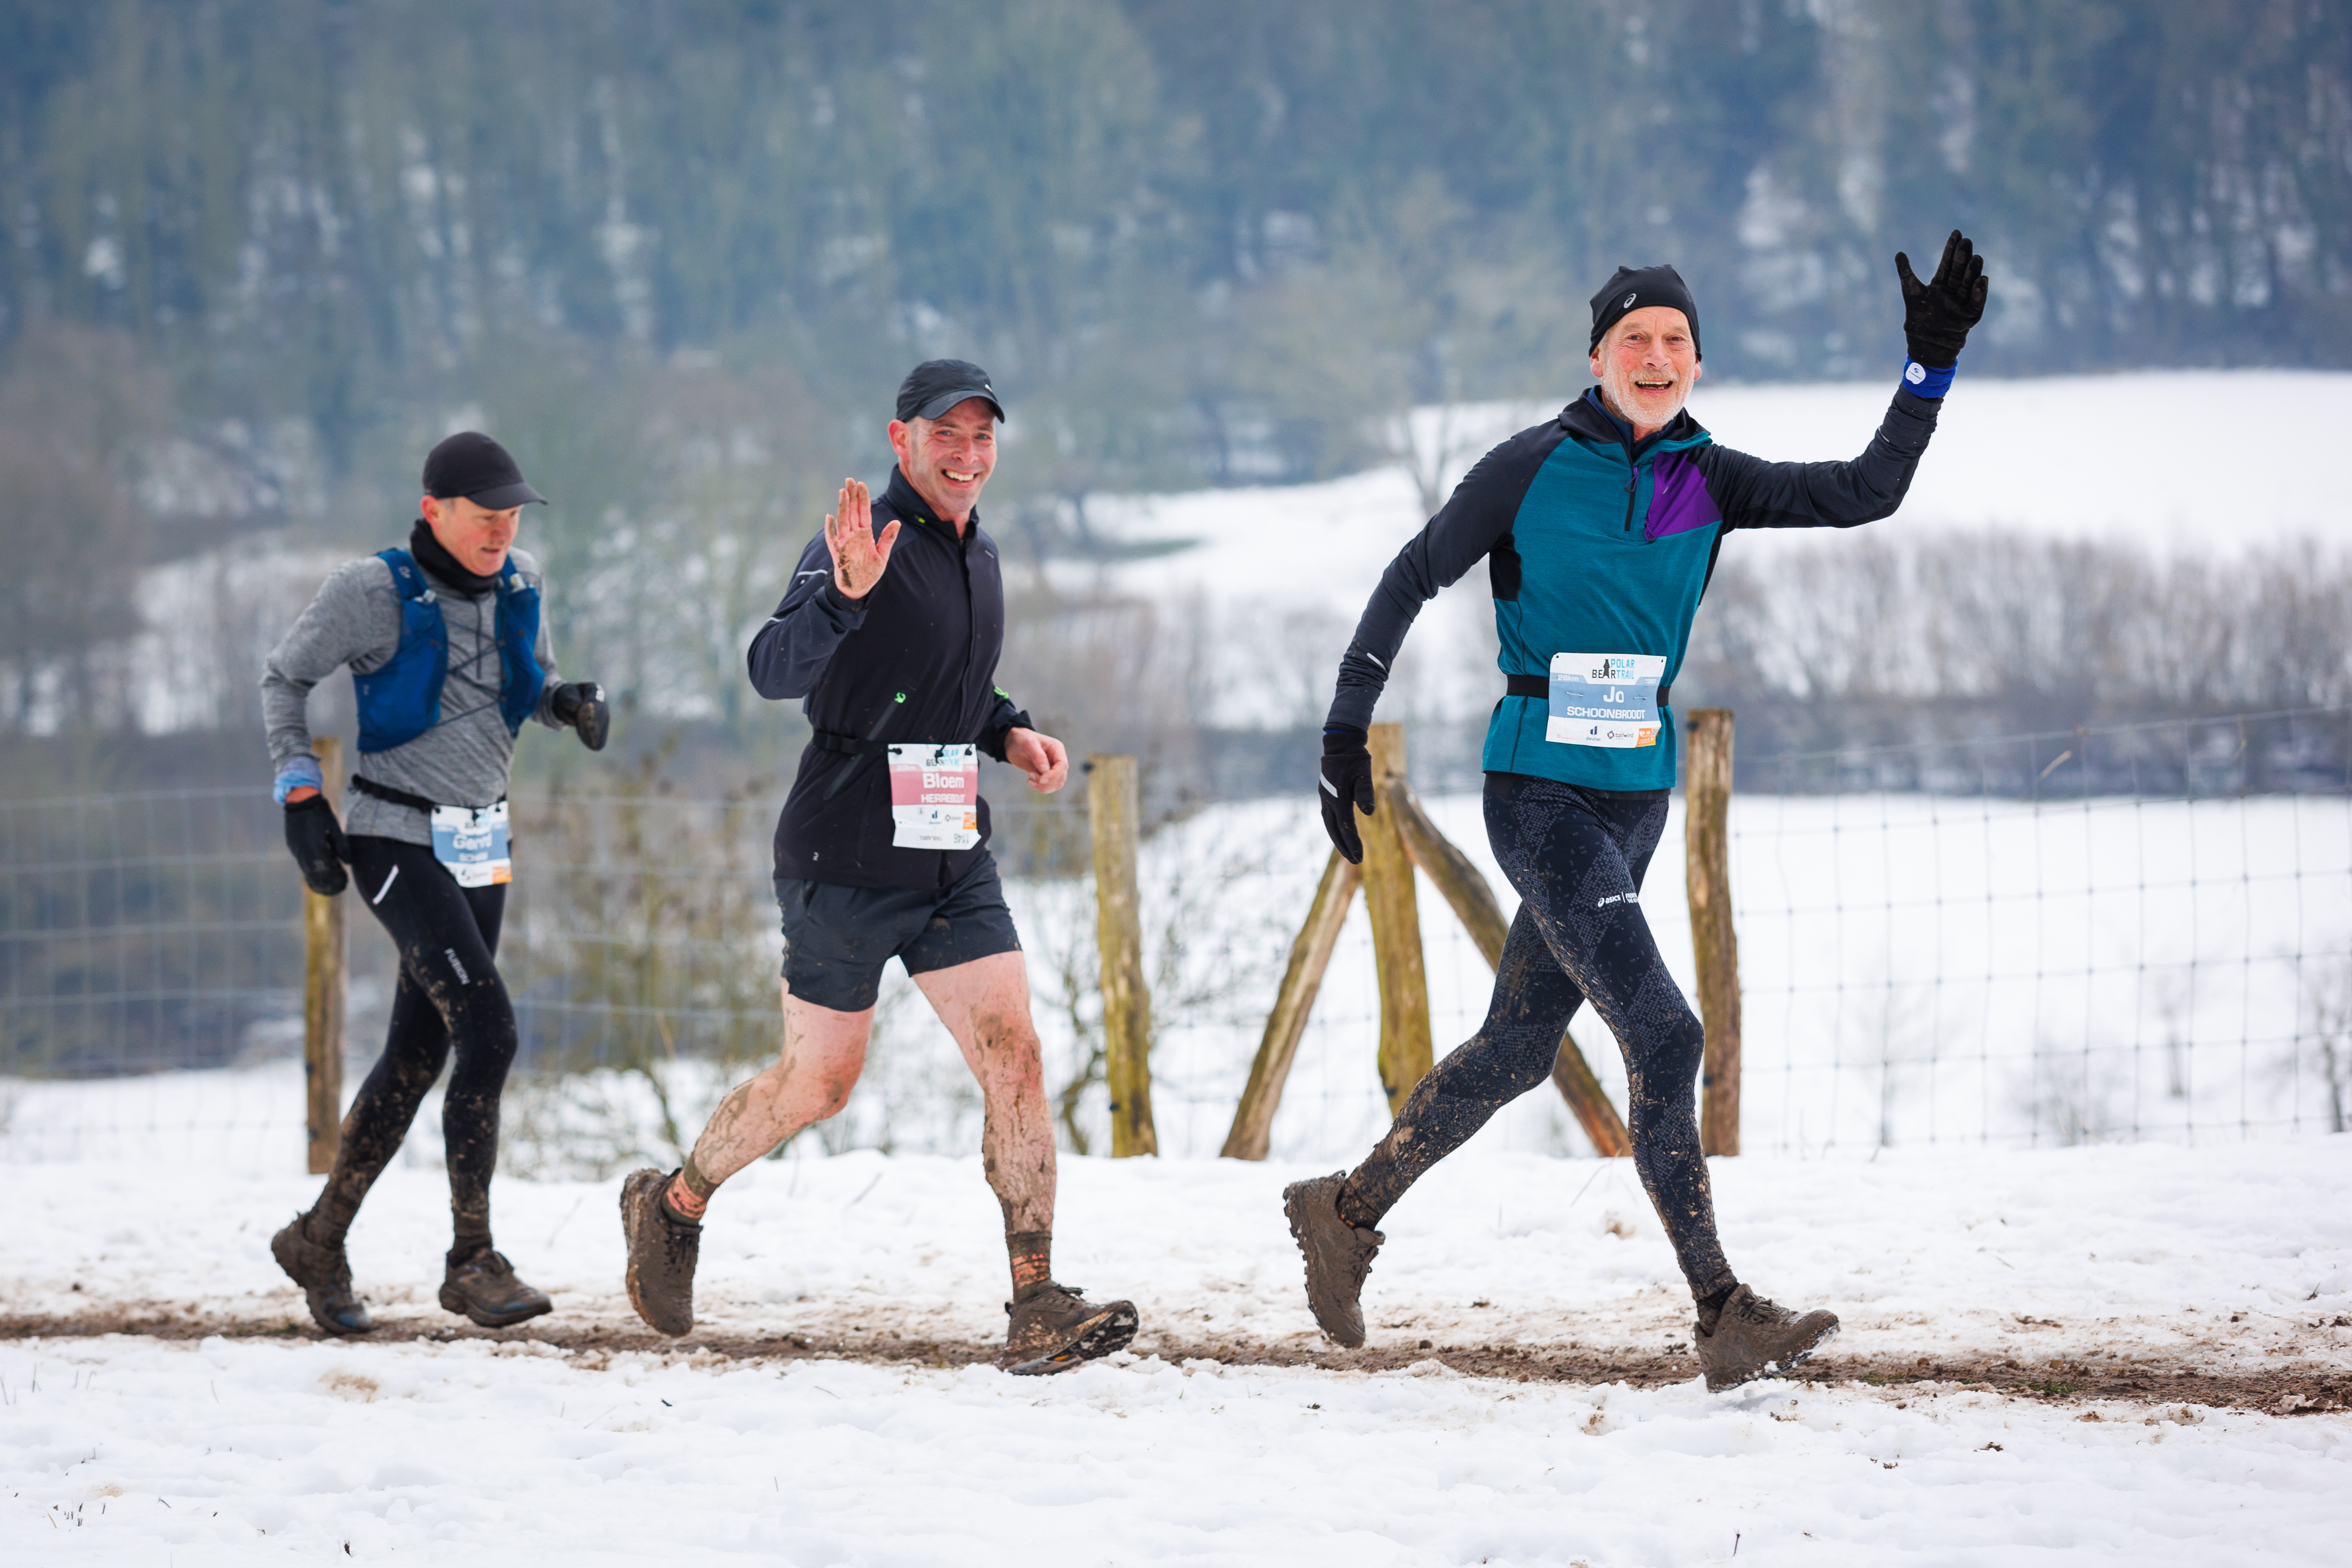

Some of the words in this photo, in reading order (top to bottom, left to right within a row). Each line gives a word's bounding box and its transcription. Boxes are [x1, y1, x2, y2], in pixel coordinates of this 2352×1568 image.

[1611, 659, 1634, 668] POLAR
[1616, 670, 1634, 679] TRAIL
[1603, 686, 1624, 703] Jo
[1567, 706, 1646, 719] SCHOONBROODT
[923, 773, 965, 789] Bloem
[1605, 895, 1621, 904] asics
